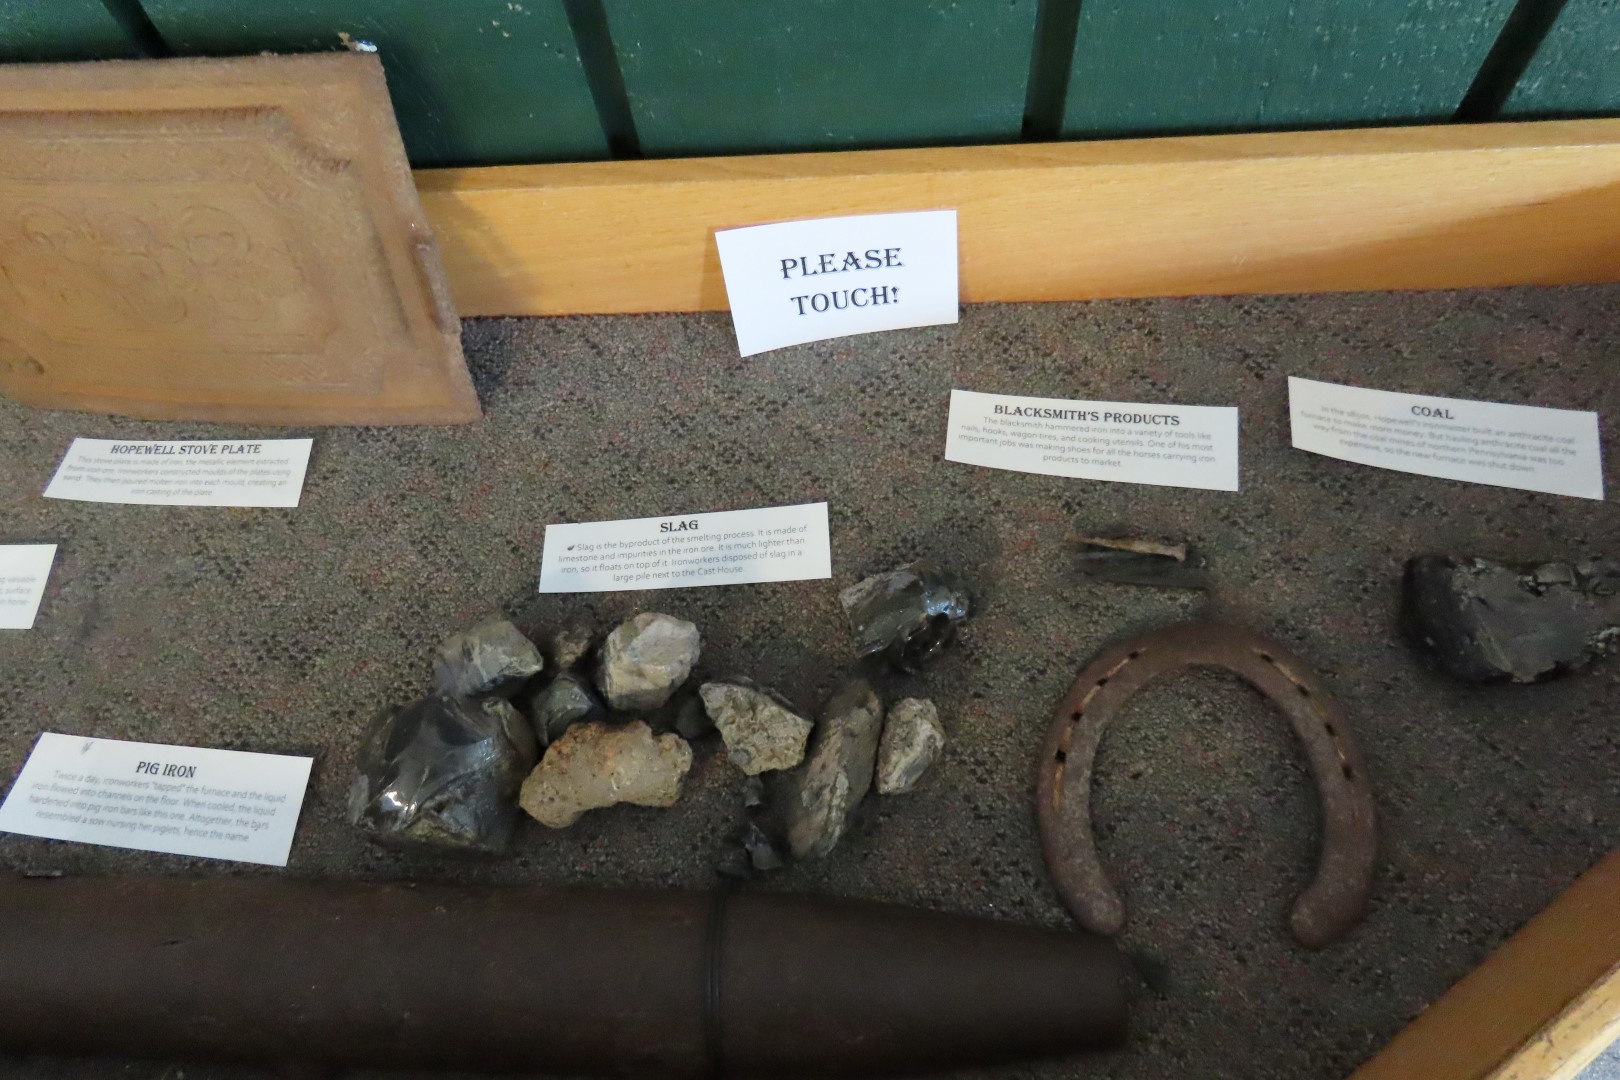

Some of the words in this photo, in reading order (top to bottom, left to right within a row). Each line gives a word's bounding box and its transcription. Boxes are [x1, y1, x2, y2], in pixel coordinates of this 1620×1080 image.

[780, 248, 902, 279] PLEASE
[790, 286, 899, 316] TOUCH!
[994, 404, 1100, 422] BLACKSMITH'S
[1104, 412, 1180, 426] PRODUCTS
[1411, 406, 1454, 420] COAL
[111, 444, 175, 454] HOPEWELL
[178, 444, 218, 454] STOVE
[221, 444, 262, 454] PLATE
[959, 432, 997, 444] important
[999, 437, 1016, 447] jobs
[1036, 442, 1065, 454] making
[1068, 444, 1090, 453] shoes
[1093, 446, 1104, 455] for
[1106, 448, 1115, 456] all
[1118, 448, 1131, 457] the
[1134, 449, 1160, 459] horses
[1163, 453, 1196, 464] carrying
[1199, 453, 1215, 462] iron
[1043, 454, 1078, 463] products
[660, 520, 699, 532] SLAG
[577, 542, 594, 552] Slag
[604, 540, 617, 548] the
[620, 538, 660, 550] byproduct
[662, 536, 671, 544] of
[672, 535, 684, 543] the
[687, 532, 720, 542] smelting
[774, 525, 796, 535] made
[799, 524, 807, 532] of
[558, 554, 598, 562] limestone
[600, 551, 615, 560] and
[618, 549, 657, 560] impurities
[668, 546, 681, 555] the
[734, 540, 756, 550] much
[759, 538, 784, 550] lighter
[786, 537, 804, 545] than
[600, 563, 621, 571] floats
[636, 561, 650, 570] top
[652, 559, 660, 567] of
[672, 555, 720, 566] Ironworkers
[722, 551, 757, 564] disposed
[760, 550, 768, 559] of
[770, 550, 786, 560] slag
[613, 573, 633, 583] large
[636, 571, 650, 582] pile
[682, 568, 695, 576] the
[698, 567, 716, 575] Cast
[135, 762, 160, 775] PIG
[162, 764, 197, 778] IRON
